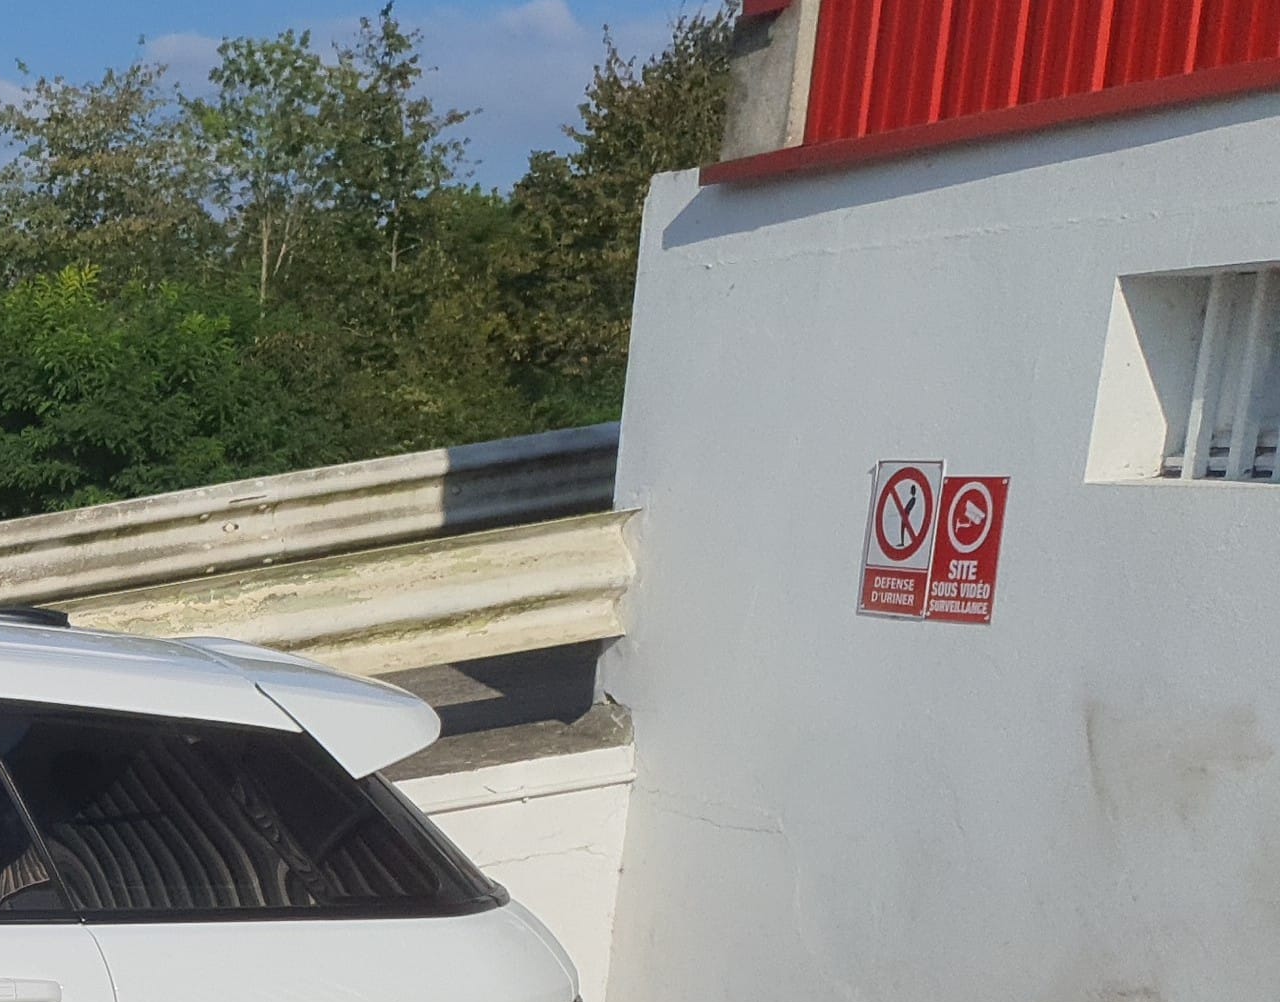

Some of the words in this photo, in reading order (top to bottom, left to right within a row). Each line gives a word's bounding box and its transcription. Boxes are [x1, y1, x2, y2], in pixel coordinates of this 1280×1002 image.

[948, 560, 977, 580] SITE
[874, 576, 914, 591] DEFENSE
[931, 581, 958, 597] SOUS
[960, 580, 990, 599] VIDÉO
[871, 591, 914, 606] D'URINER
[929, 599, 988, 614] SURVEILLANCE
